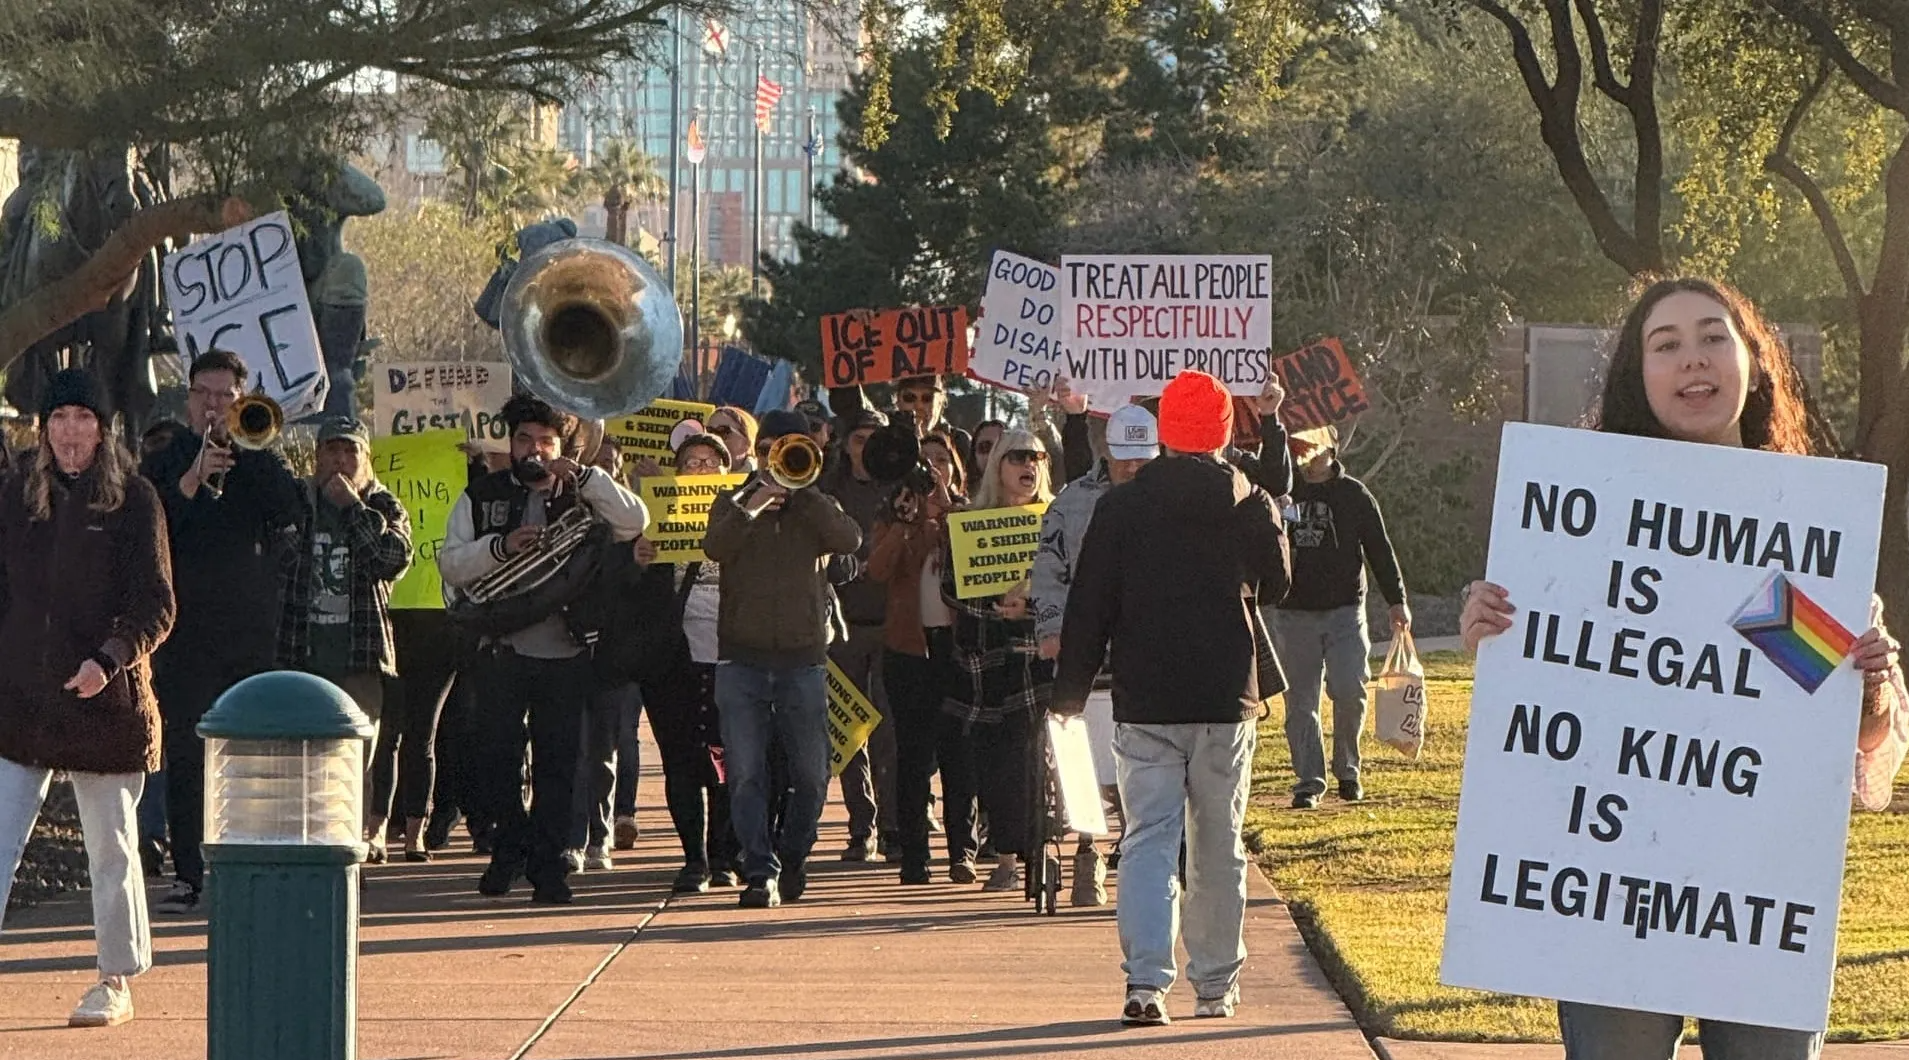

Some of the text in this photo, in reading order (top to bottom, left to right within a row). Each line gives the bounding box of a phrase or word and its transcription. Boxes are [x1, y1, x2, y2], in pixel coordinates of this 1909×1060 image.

[174, 223, 290, 316] STOP
[995, 258, 1056, 292] GOOD
[1066, 262, 1269, 300] TREAT ALL PEOPLE
[1021, 297, 1054, 325] DO
[1076, 303, 1254, 340] RESPECTFULLY
[831, 307, 959, 351] ICE OUT
[388, 365, 489, 393] DEFUND
[832, 350, 874, 385] OF
[1066, 347, 1127, 380] WITH
[1135, 348, 1179, 380] DUE
[1282, 345, 1340, 394] AND
[625, 420, 634, 431] &
[372, 449, 408, 474] CE
[667, 504, 677, 515] &
[961, 514, 1037, 533] WARNING
[977, 538, 988, 548] &
[1521, 482, 1841, 578] NO HUMAN
[963, 569, 1020, 586] PEOPLE
[1607, 560, 1663, 615] IS
[1523, 610, 1761, 698] ILLEGAL
[1504, 704, 1762, 798] NO KING
[1568, 786, 1628, 842] IS
